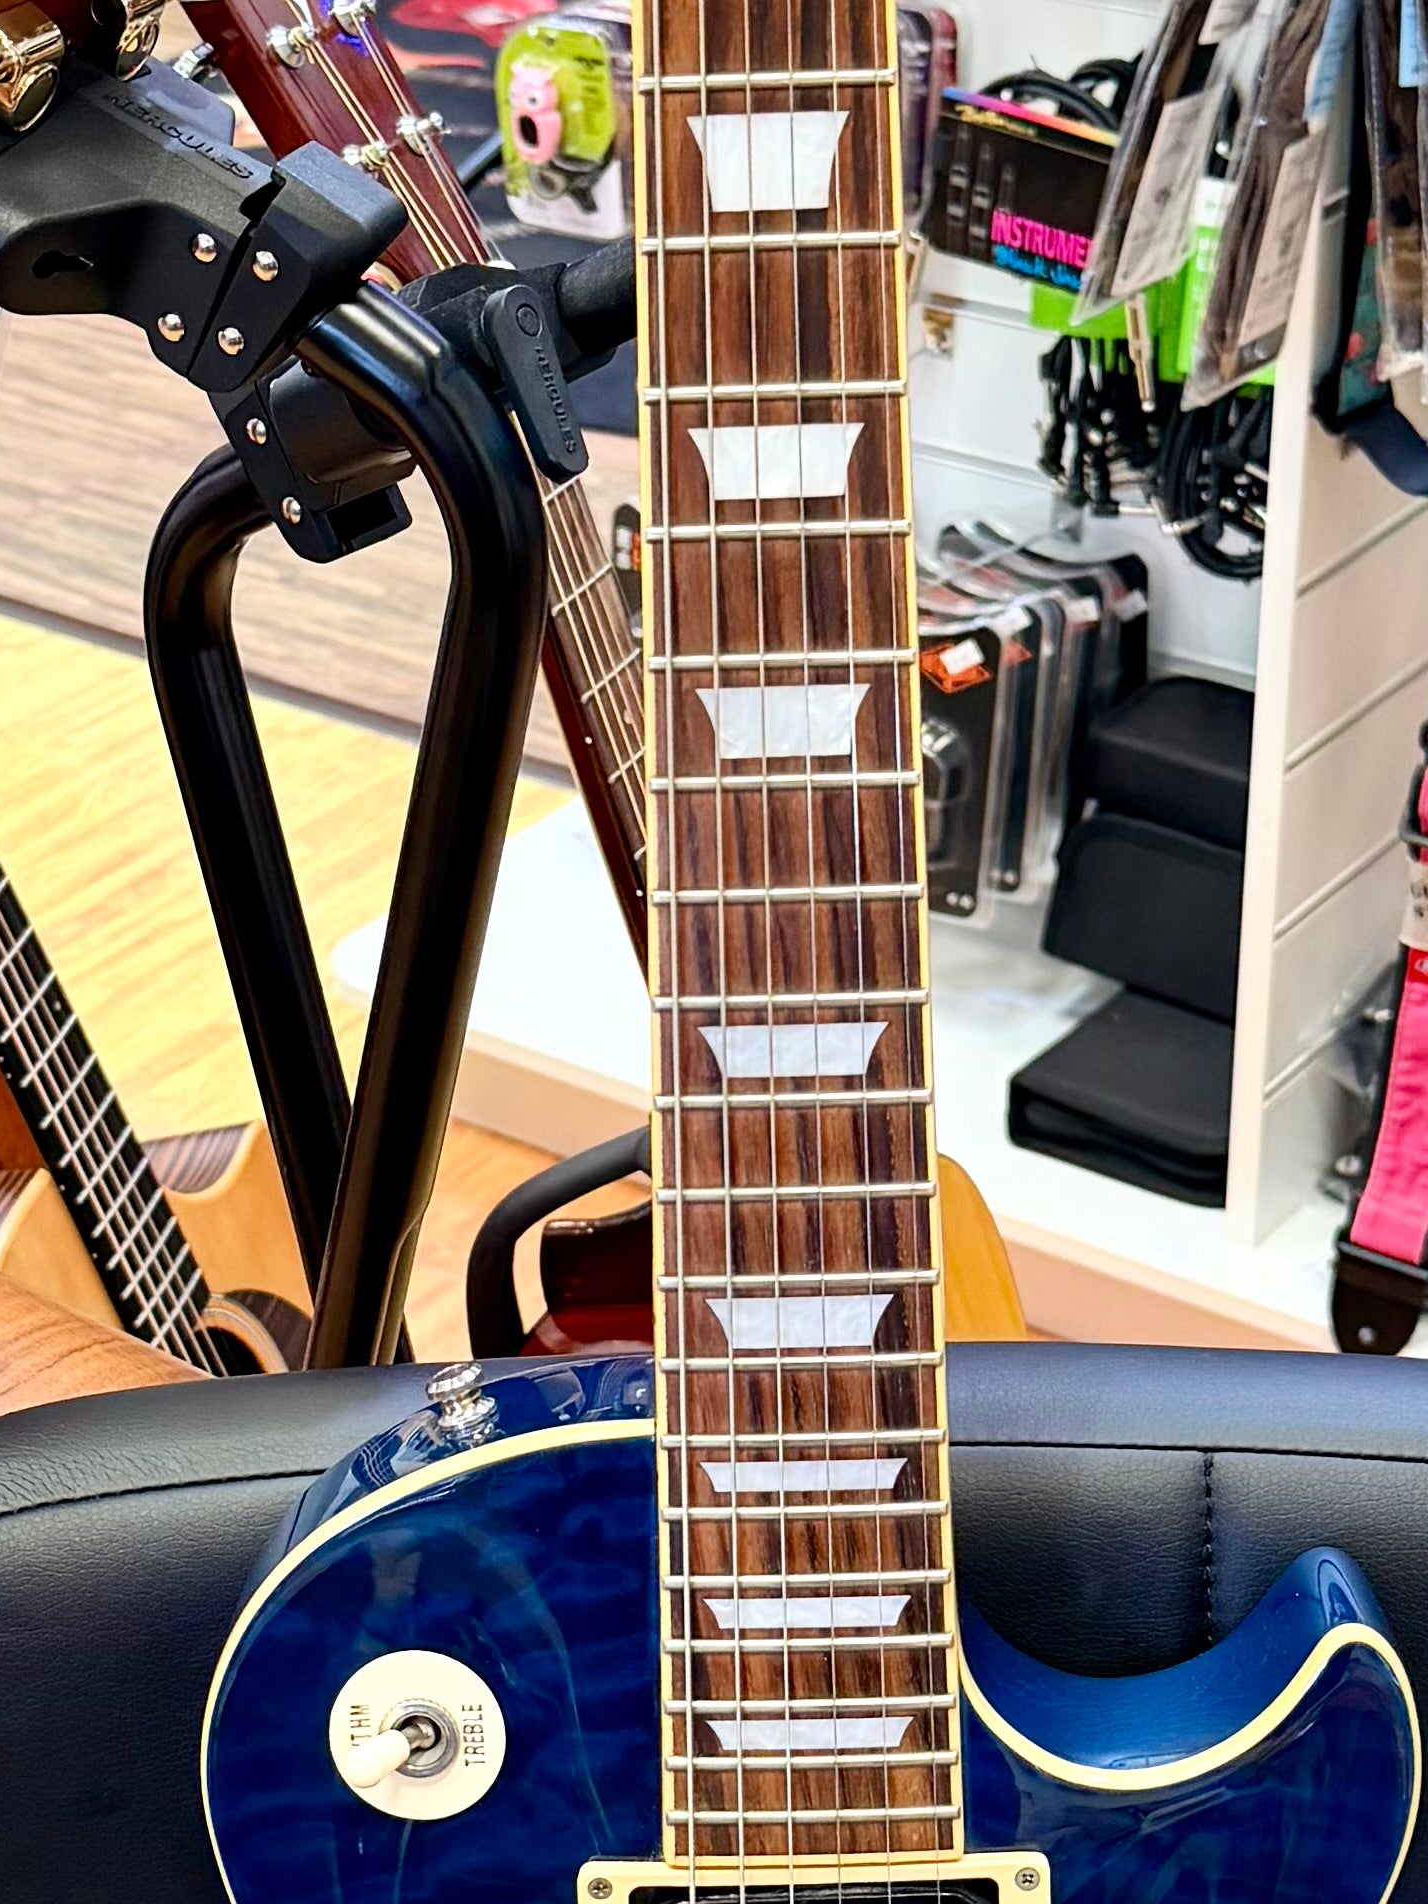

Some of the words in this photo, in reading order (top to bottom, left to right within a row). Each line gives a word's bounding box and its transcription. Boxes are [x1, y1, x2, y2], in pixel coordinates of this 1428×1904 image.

[105, 93, 255, 180] HERCULES
[990, 206, 1093, 271] INSTRUME
[533, 345, 579, 456] HERCULES
[349, 1704, 372, 1747] THM
[461, 1703, 486, 1767] TREBLE
